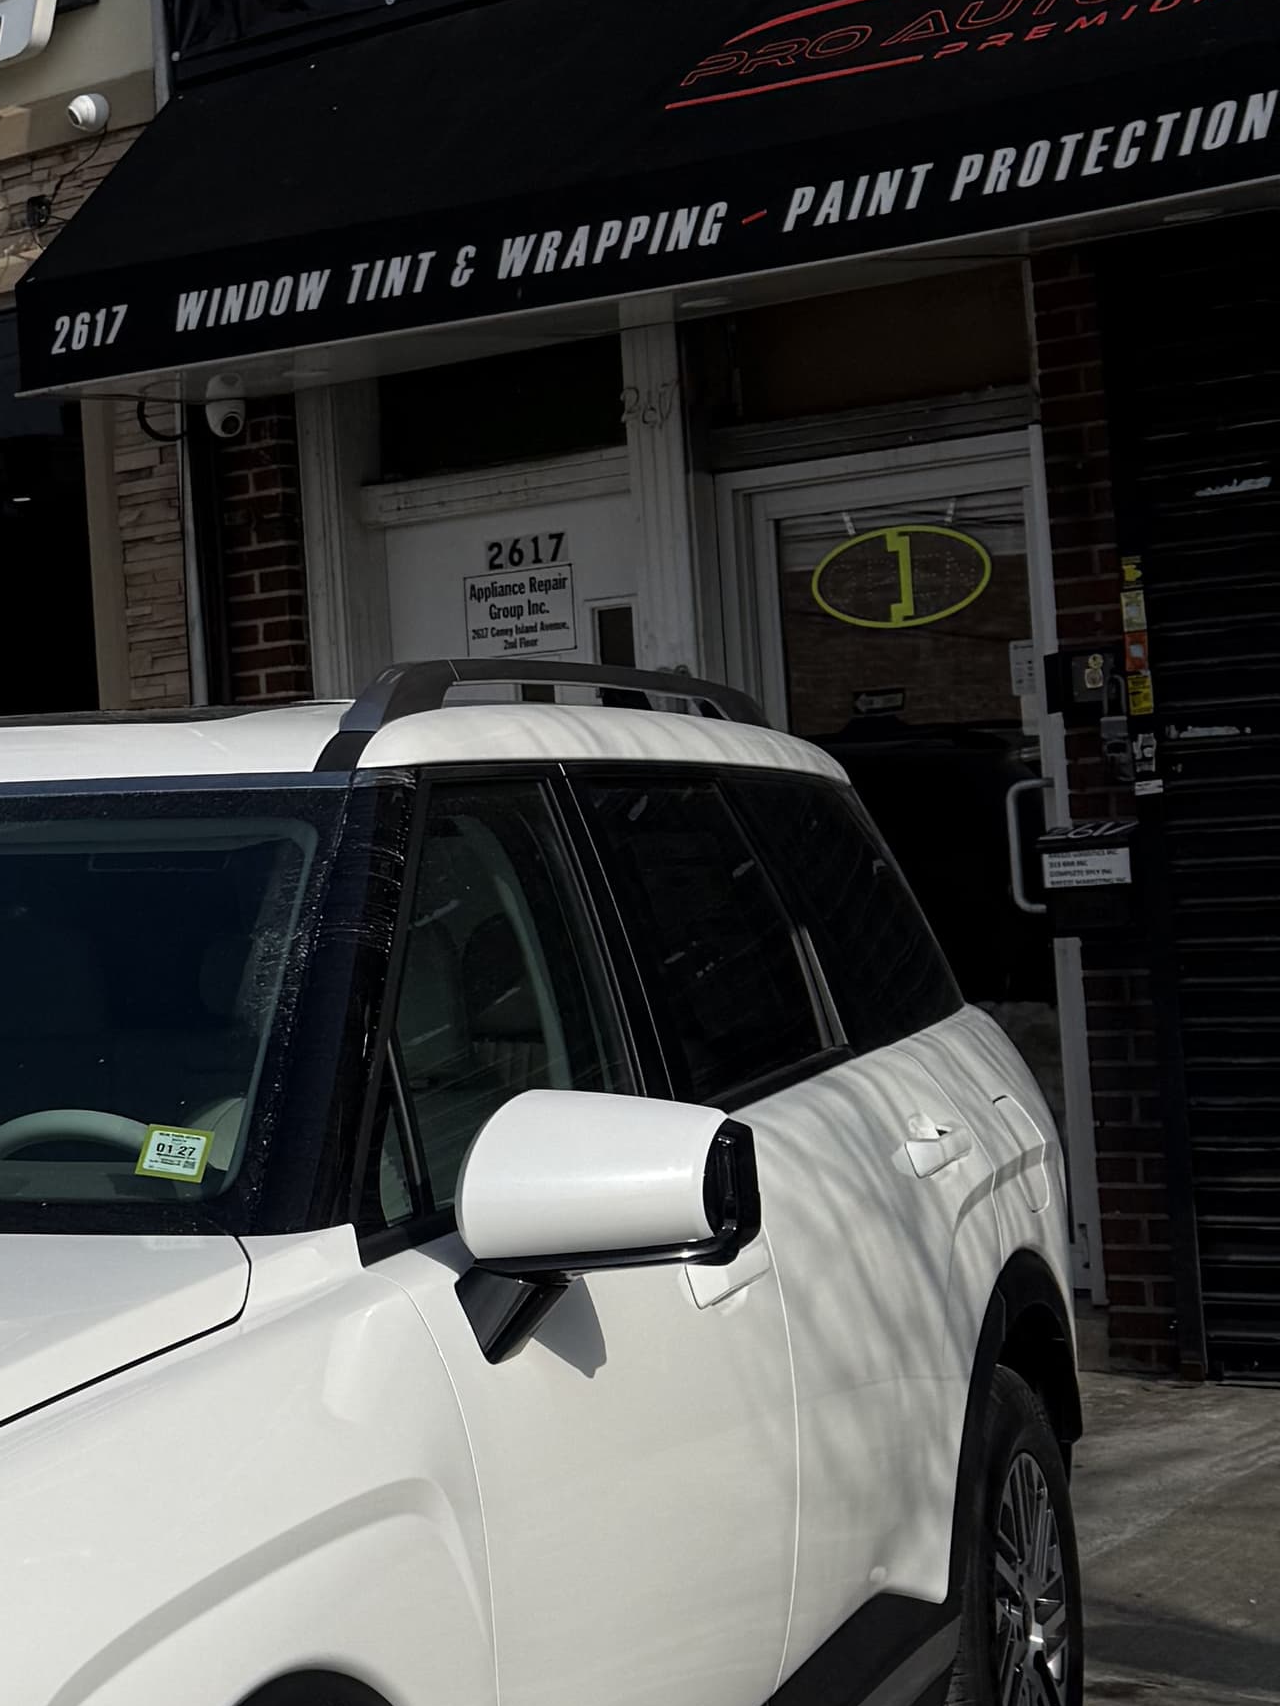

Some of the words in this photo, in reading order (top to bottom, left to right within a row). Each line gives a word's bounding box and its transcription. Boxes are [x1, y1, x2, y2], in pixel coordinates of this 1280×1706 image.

[680, 25, 872, 86] PRO
[51, 304, 128, 355] 2617
[175, 269, 331, 333] WINDOW
[346, 250, 437, 304] TINT
[450, 245, 476, 288] &
[497, 201, 729, 279] WRAPPING
[782, 162, 936, 232] PAINT
[949, 89, 1280, 203] PROTECTION
[488, 532, 565, 571] 2617
[469, 580, 526, 603] Appliance
[529, 572, 568, 594] Repair
[489, 603, 524, 620] Group
[527, 599, 550, 616] Inc.
[157, 1143, 173, 1154] 01
[177, 1146, 196, 1157] 27
